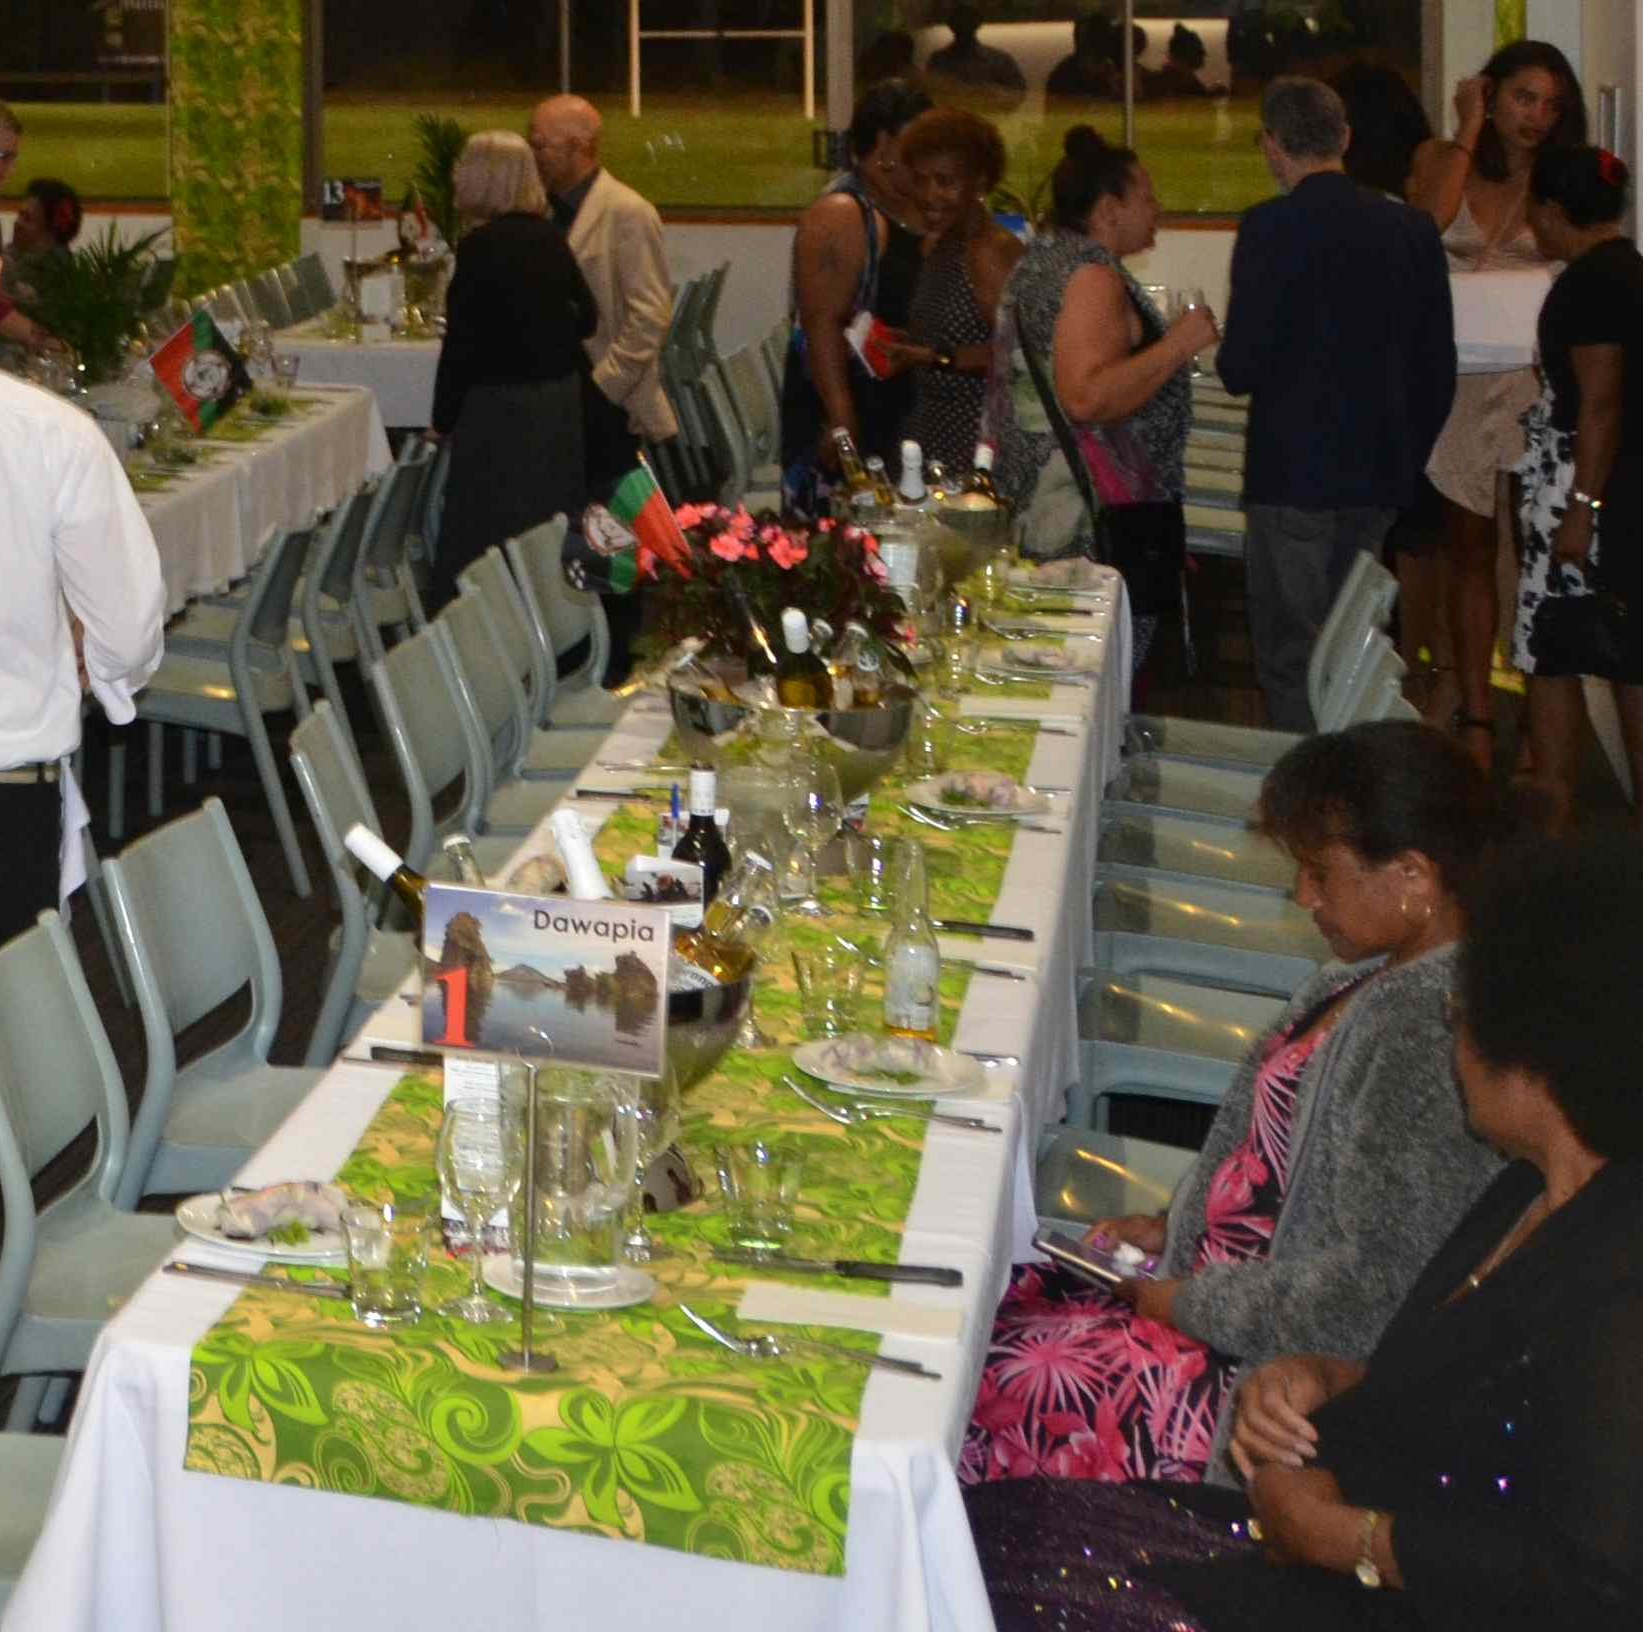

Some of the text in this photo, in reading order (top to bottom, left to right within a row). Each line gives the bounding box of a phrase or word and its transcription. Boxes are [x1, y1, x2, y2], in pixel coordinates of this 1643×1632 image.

[324, 180, 345, 204] 13
[534, 909, 654, 943] Dawapia
[434, 965, 475, 1049] 1
